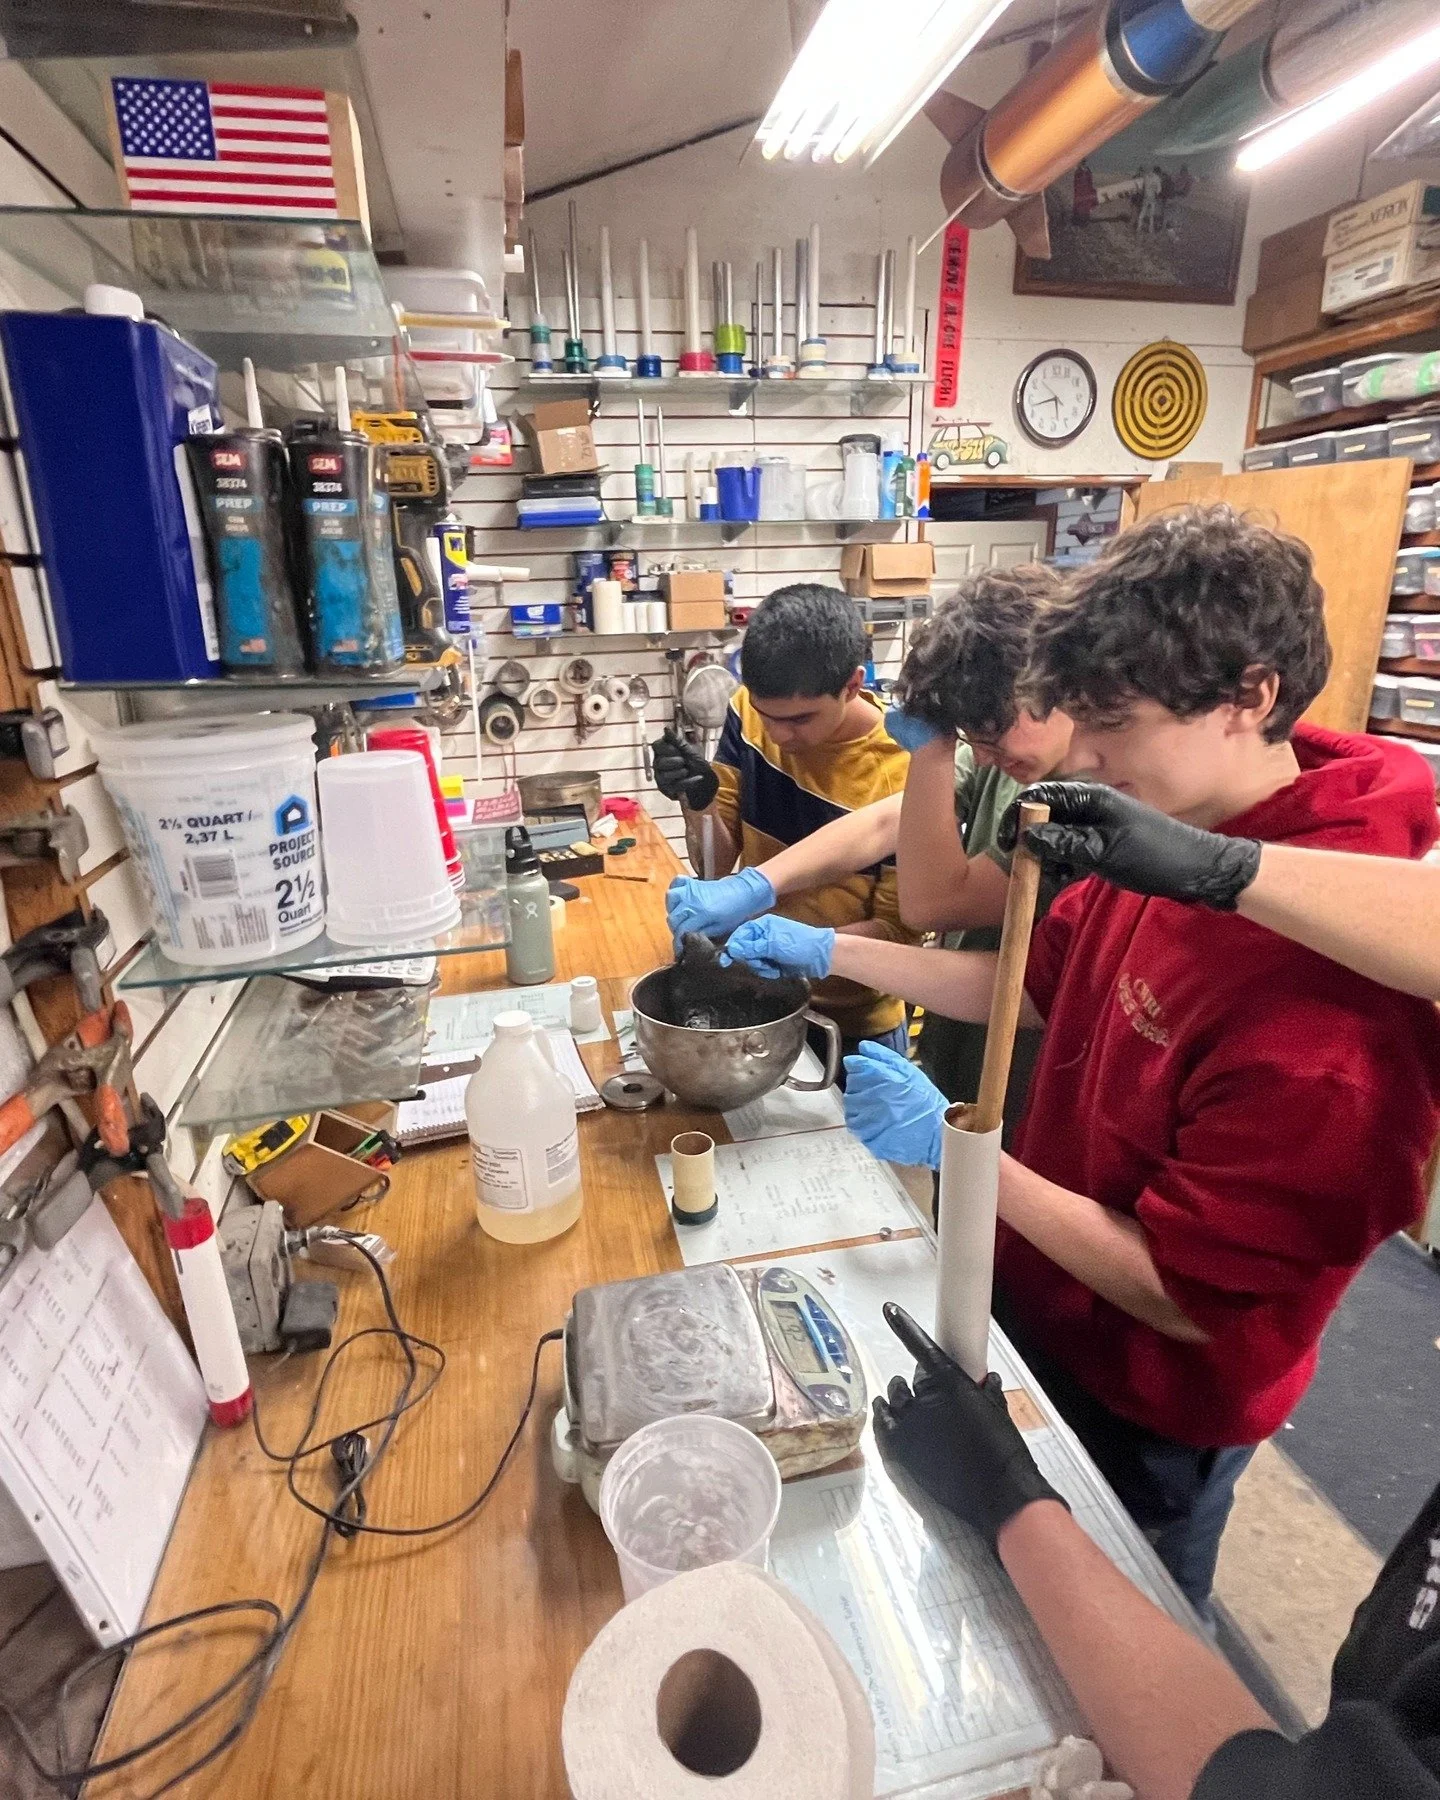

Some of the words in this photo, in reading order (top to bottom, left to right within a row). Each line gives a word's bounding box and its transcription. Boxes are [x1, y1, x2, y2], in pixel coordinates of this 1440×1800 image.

[215, 497, 253, 509] PREP
[312, 501, 347, 512] PREP
[187, 811, 243, 829] QUART
[224, 829, 234, 841] L
[269, 829, 315, 856] PROJECT
[273, 844, 315, 871] SOURCE
[278, 902, 312, 923] Quart
